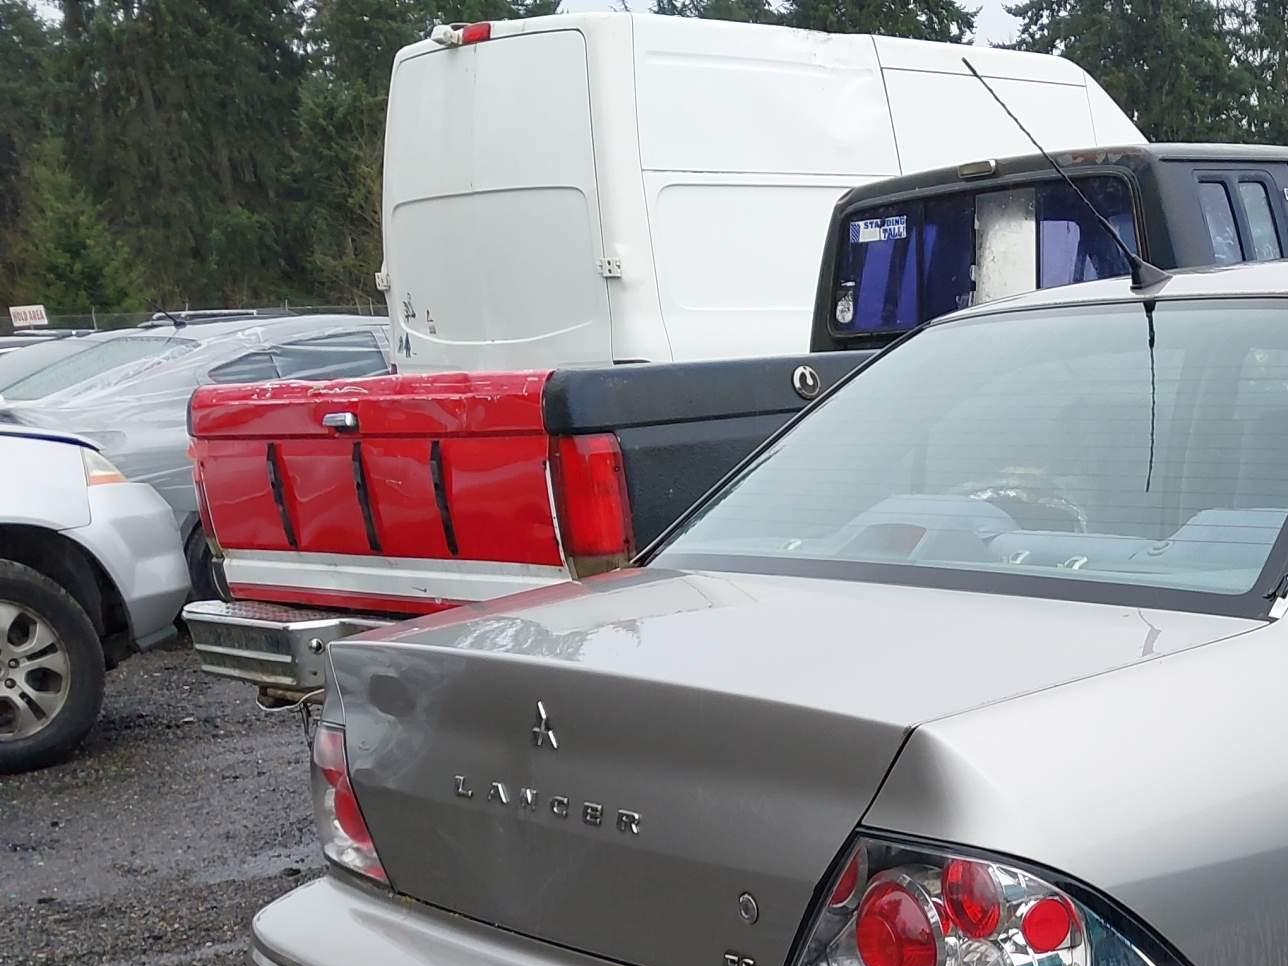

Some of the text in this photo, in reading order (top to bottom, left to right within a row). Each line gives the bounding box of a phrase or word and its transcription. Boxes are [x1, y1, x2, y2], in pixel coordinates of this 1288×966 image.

[863, 216, 905, 229] STADING
[882, 226, 905, 239] TALL!
[12, 310, 46, 321] HOLD AREA
[454, 774, 642, 835] LANCER
